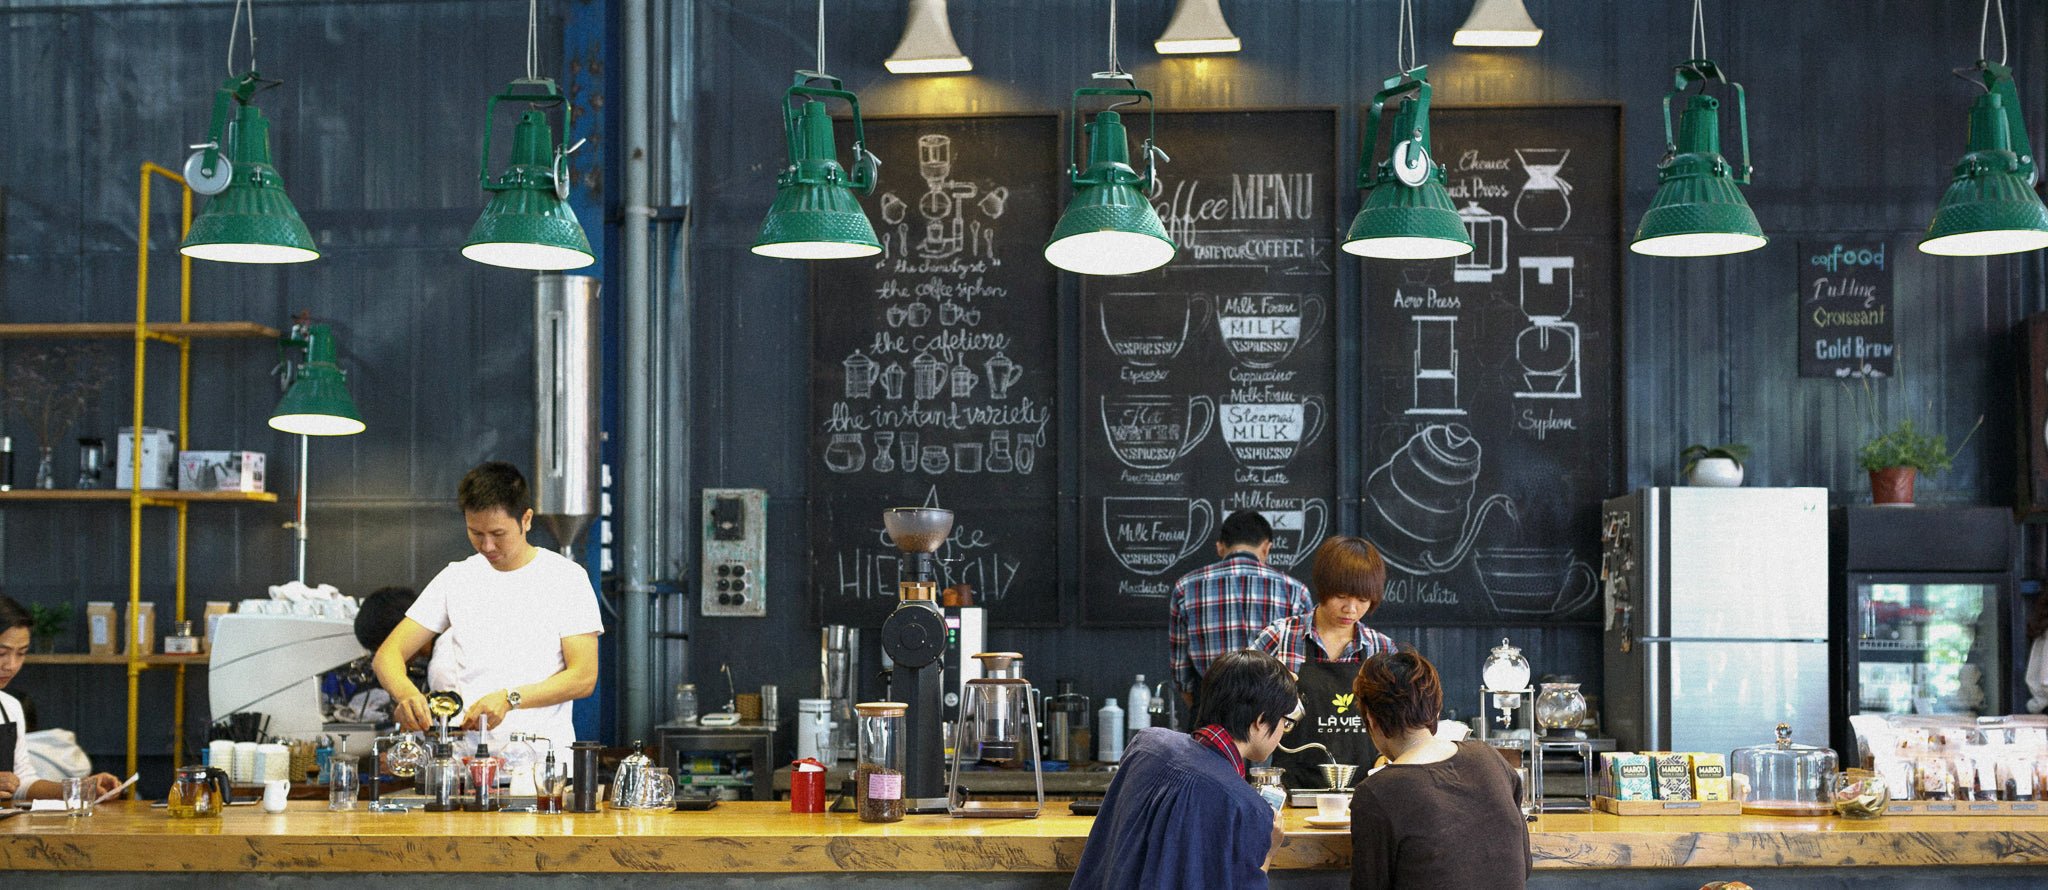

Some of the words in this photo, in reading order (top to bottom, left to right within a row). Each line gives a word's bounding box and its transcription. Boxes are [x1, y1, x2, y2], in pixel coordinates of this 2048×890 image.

[1459, 150, 1510, 171] Chemex
[1473, 176, 1510, 198] Press
[1231, 173, 1313, 220] MENU
[1194, 245, 1220, 259] TASTE
[1220, 245, 1245, 259] YOUR
[1245, 239, 1304, 260] COFFEE
[876, 279, 910, 299] the
[915, 276, 953, 301] coffee
[955, 277, 1008, 302] siphon
[1394, 289, 1422, 308] Aero
[1427, 288, 1461, 308] Press
[1224, 298, 1258, 315] Milk
[1261, 297, 1297, 314] Foam
[1813, 305, 1885, 328] Croissant
[1231, 319, 1290, 336] MILK
[870, 332, 909, 354] the
[912, 329, 1010, 364] cafetiere
[1115, 341, 1178, 355] ESPRESSO
[1231, 341, 1288, 353] ESPRESSO
[1816, 337, 1851, 359] Cold
[1855, 336, 1893, 358] Brew
[1120, 366, 1170, 384] Espresso
[1229, 367, 1297, 388] Cappuccino
[1230, 386, 1263, 403] Milk
[1265, 384, 1296, 403] Foam
[824, 402, 870, 432] the
[871, 401, 965, 430] instant
[963, 397, 1050, 447] variety
[1228, 406, 1296, 424] Steamed
[1518, 409, 1577, 439] Syphon
[1110, 424, 1181, 441] WATER
[1233, 424, 1289, 440] MILK
[1119, 447, 1177, 461] ESPRESSO
[1236, 447, 1292, 460] ESPRESSO
[1121, 470, 1183, 483] Americano
[1261, 469, 1290, 484] Latte
[1234, 490, 1264, 508] Milk
[1265, 491, 1296, 509] Foam
[1117, 522, 1149, 541] Milk
[1152, 521, 1186, 541] Foam
[1121, 553, 1176, 565] ESPRESSO
[1118, 580, 1170, 594] Macchiato
[1417, 580, 1459, 604] Kalita
[1318, 715, 1337, 726] LÀ
[1340, 715, 1363, 728] VIỆ
[1662, 765, 1684, 773] MAROU
[1700, 766, 1722, 774] MAROU
